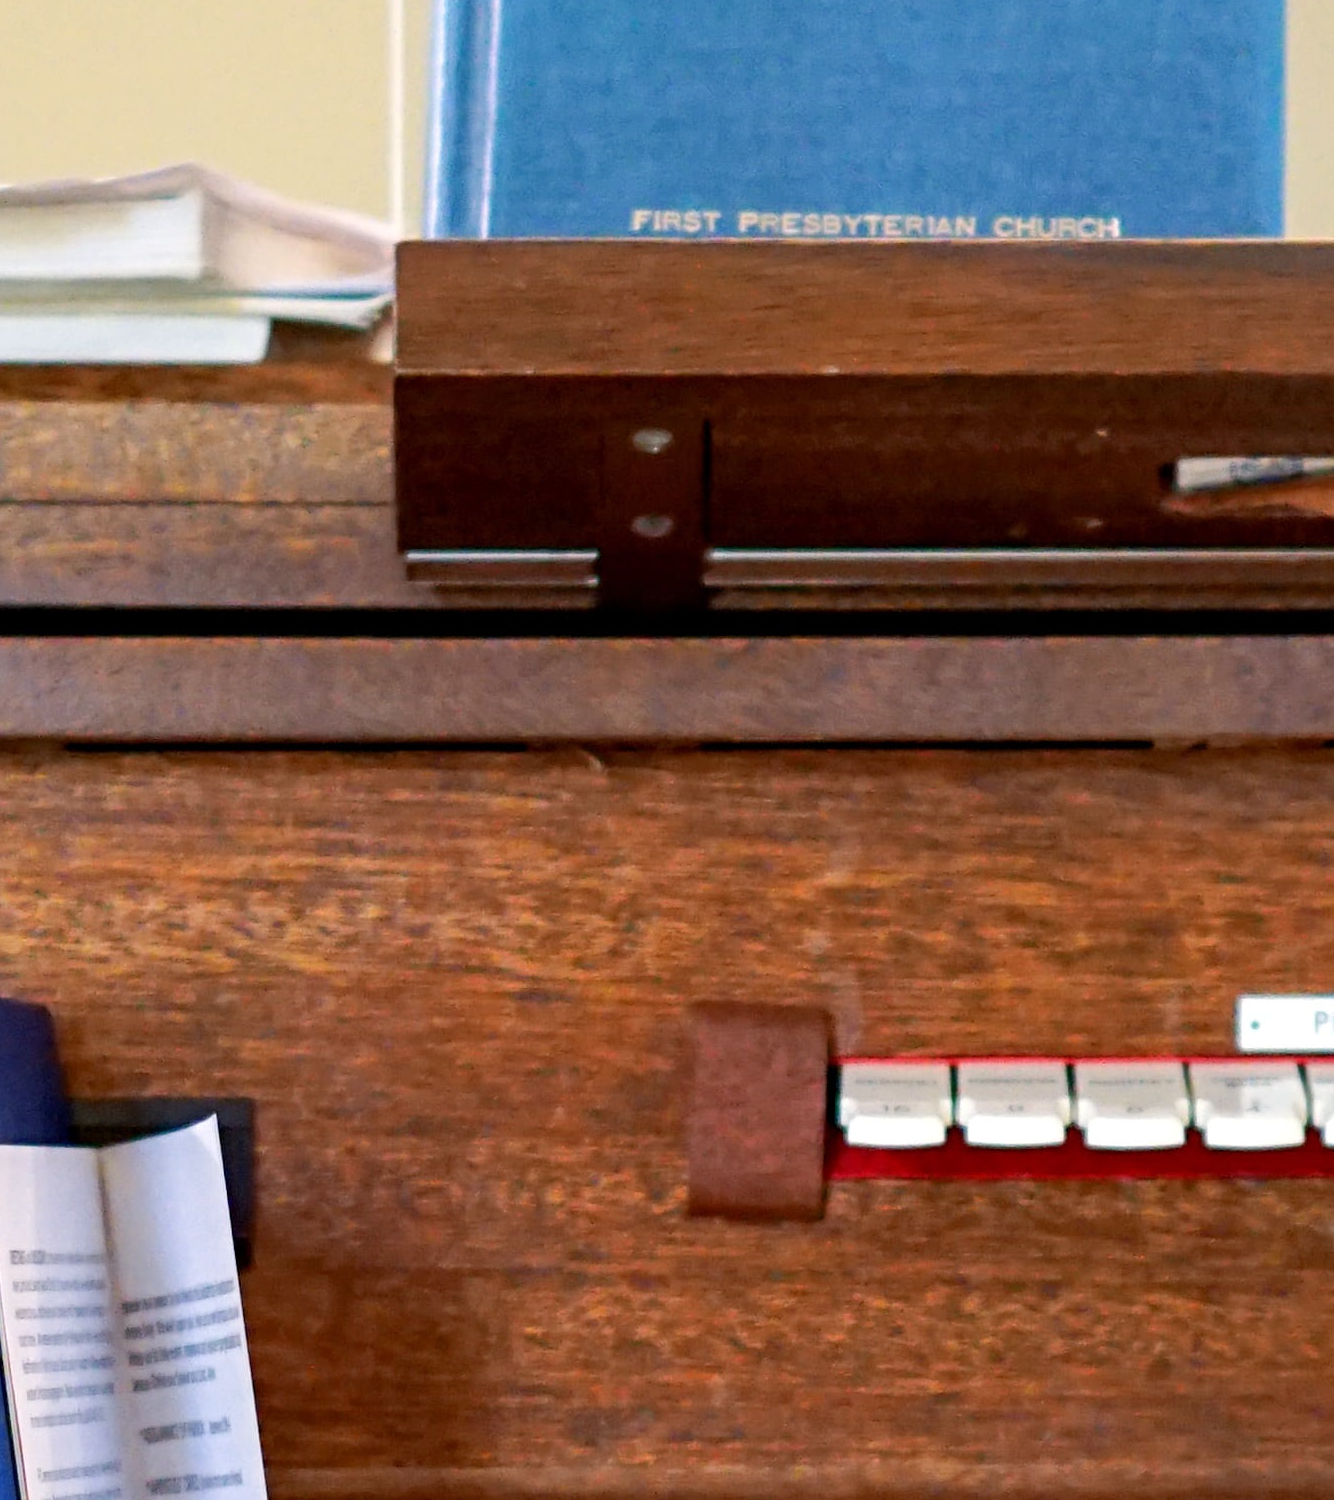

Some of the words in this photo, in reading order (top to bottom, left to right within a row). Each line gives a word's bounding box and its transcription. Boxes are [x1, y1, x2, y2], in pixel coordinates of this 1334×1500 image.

[631, 209, 722, 233] FIRST
[738, 211, 977, 237] PRESBYTERIAN
[993, 216, 1121, 239] CHURCH
